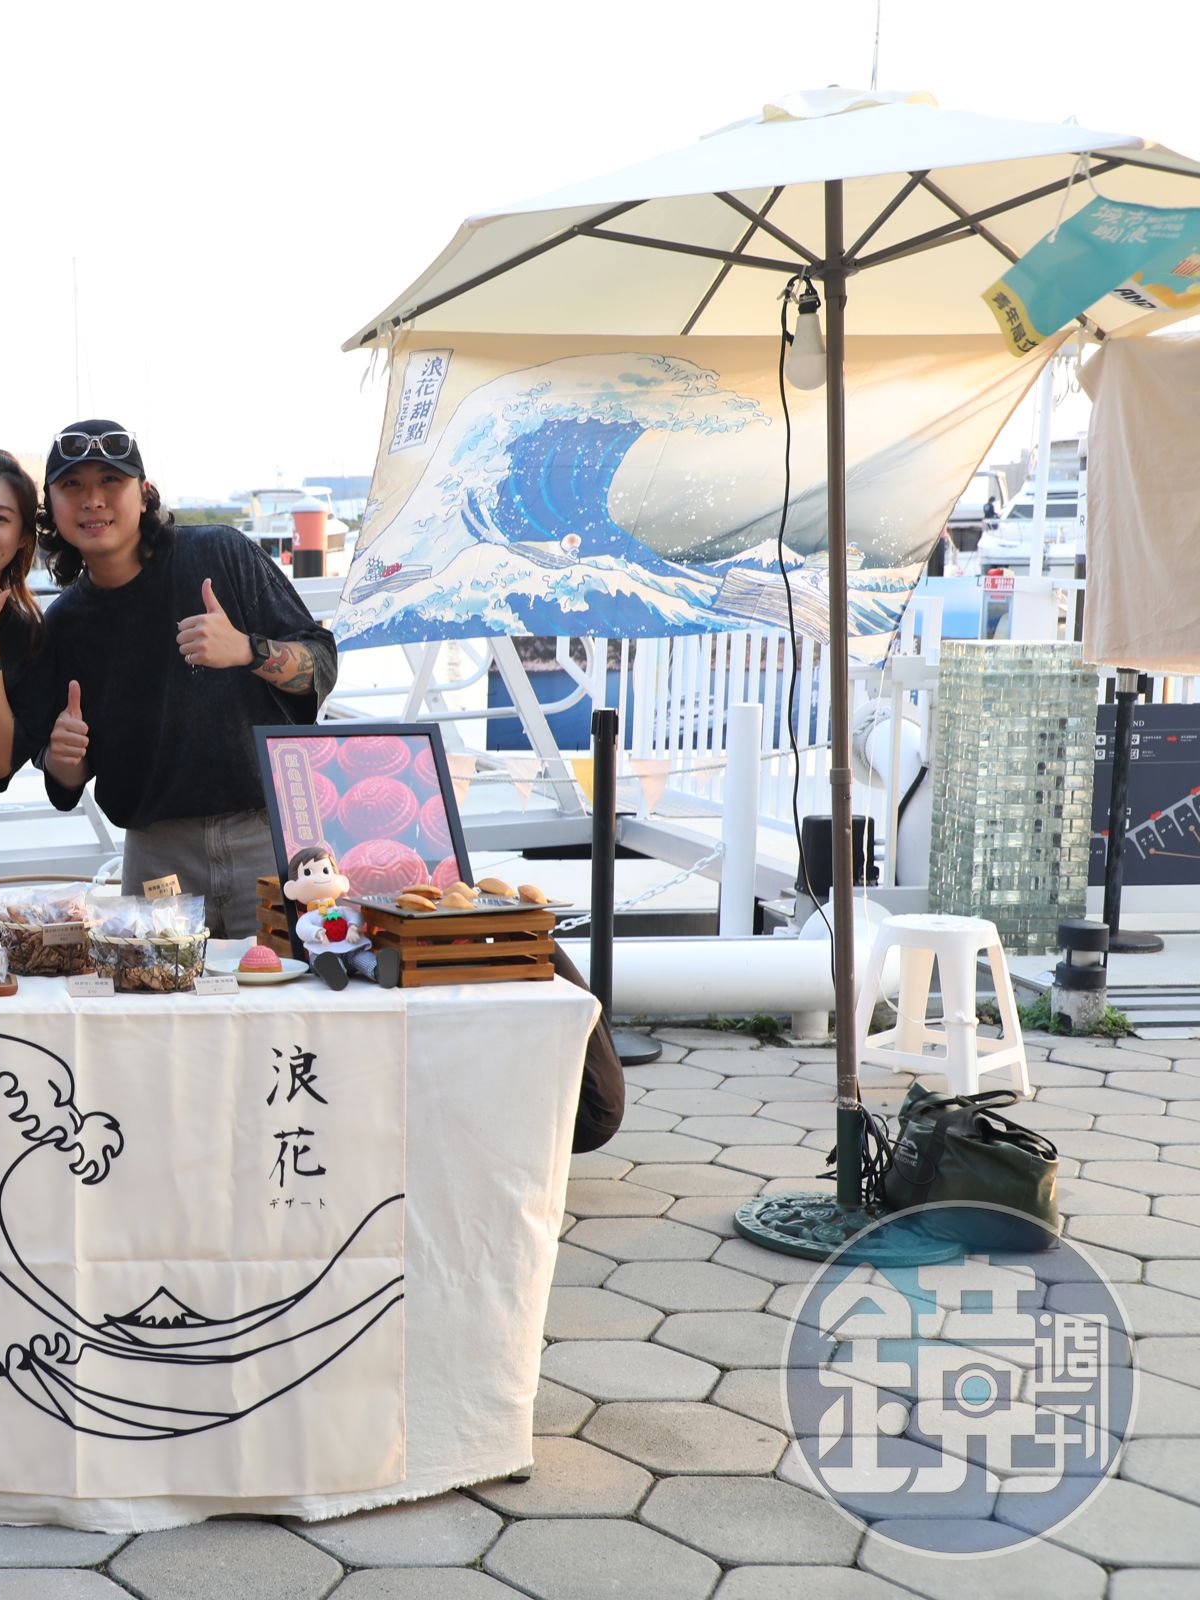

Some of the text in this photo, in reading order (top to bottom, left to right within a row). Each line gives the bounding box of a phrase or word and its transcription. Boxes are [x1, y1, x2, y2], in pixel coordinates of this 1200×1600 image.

[393, 388, 412, 446] SPINDRIFT
[403, 355, 443, 444] 浪花甜點
[266, 1044, 329, 1188] 浪花
[269, 1197, 326, 1210] デザート
